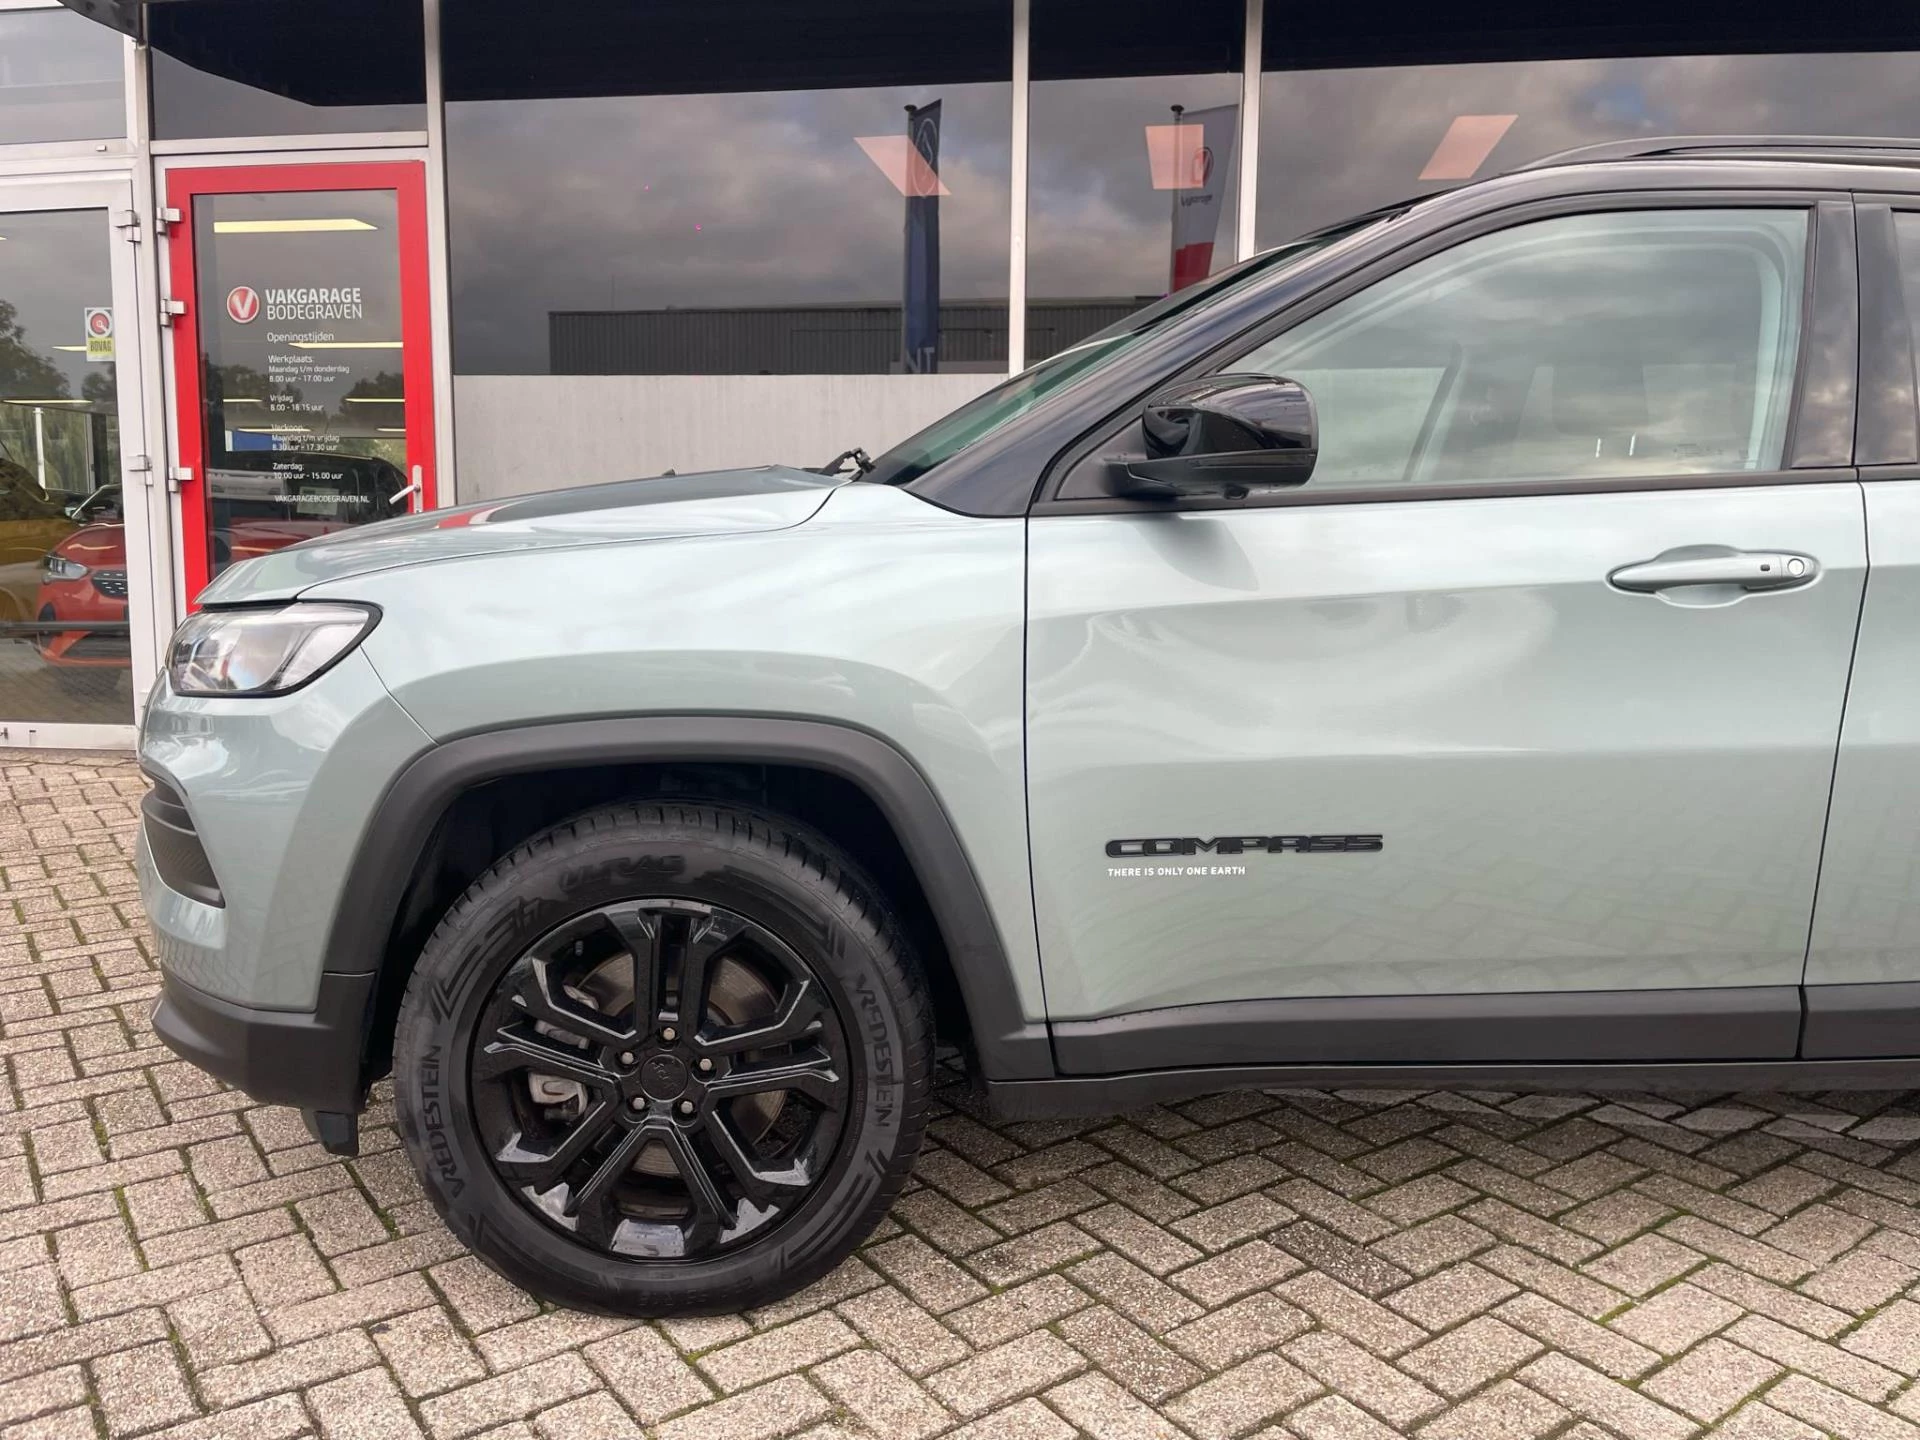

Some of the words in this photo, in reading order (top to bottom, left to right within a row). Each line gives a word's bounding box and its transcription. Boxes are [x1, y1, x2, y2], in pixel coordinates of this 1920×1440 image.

[265, 288, 361, 304] VAKGARAGE
[266, 304, 362, 320] BODEGRAVEN
[267, 332, 334, 344] Openingstijden
[90, 340, 112, 352] BOVAG
[268, 366, 298, 374] Maandag
[314, 365, 350, 374] donderdag
[271, 434, 302, 444] Maandag
[303, 434, 316, 442] t/m
[317, 434, 340, 444] vrijdag
[306, 443, 325, 451] 17.30
[274, 494, 370, 503] VAKGARAGEBODEGRAVEN.NL
[1105, 834, 1384, 858] COMPASS
[1107, 867, 1141, 877] THERE
[1144, 867, 1154, 876] IS
[1157, 866, 1184, 876] ONLY
[1187, 866, 1208, 876] ONE
[1211, 866, 1246, 876] EARTH
[420, 1045, 466, 1199] VREDESTEIN
